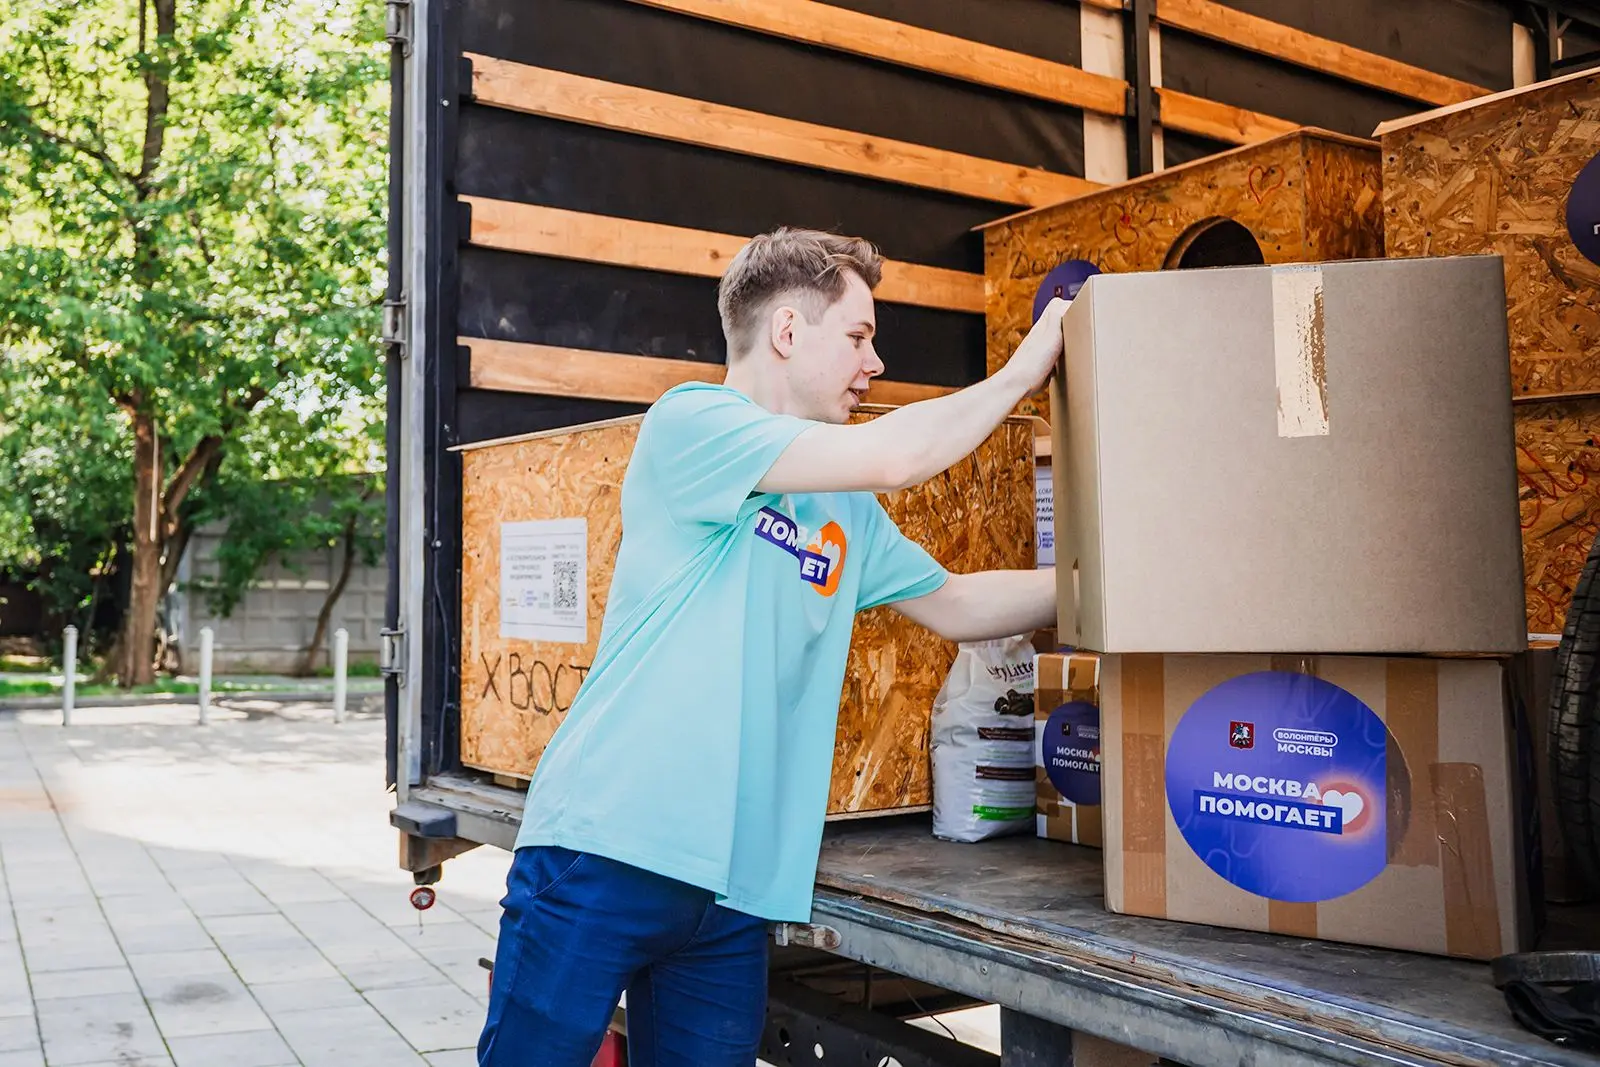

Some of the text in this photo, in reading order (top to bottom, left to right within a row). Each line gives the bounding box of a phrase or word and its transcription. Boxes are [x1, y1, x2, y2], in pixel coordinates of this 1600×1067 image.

[756, 510, 827, 580] ПОМЕТ
[1056, 746, 1095, 760] МОСКВА
[1277, 743, 1333, 757] МОСКВЫ
[1052, 757, 1100, 772] ПОМОГАЕТ
[1213, 772, 1322, 800] МОСКВА
[1200, 795, 1337, 829] ПОМОГАЕТ
